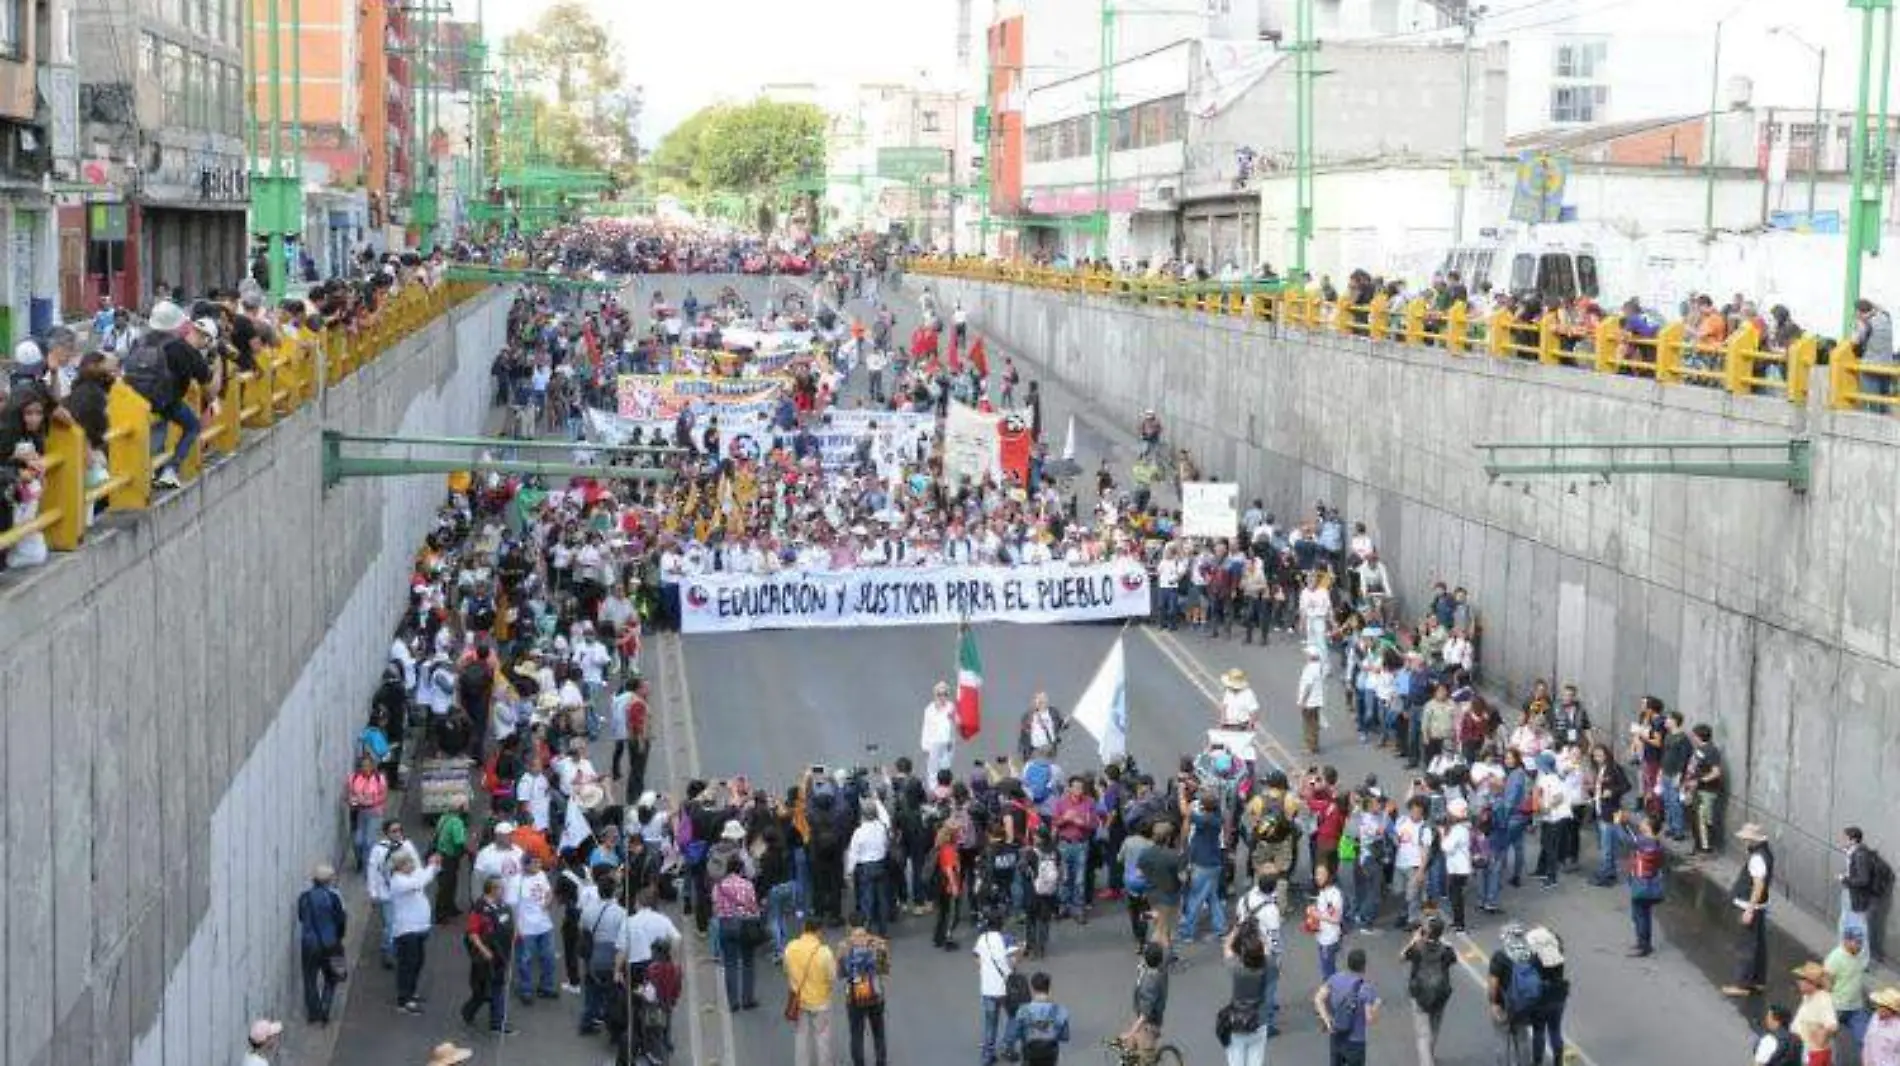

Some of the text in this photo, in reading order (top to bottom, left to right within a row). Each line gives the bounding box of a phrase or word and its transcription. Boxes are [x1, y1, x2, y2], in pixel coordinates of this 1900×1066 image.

[717, 572, 1114, 617] EDUCACIÓN Y JUSTICIA PARA EL PUEBLO
